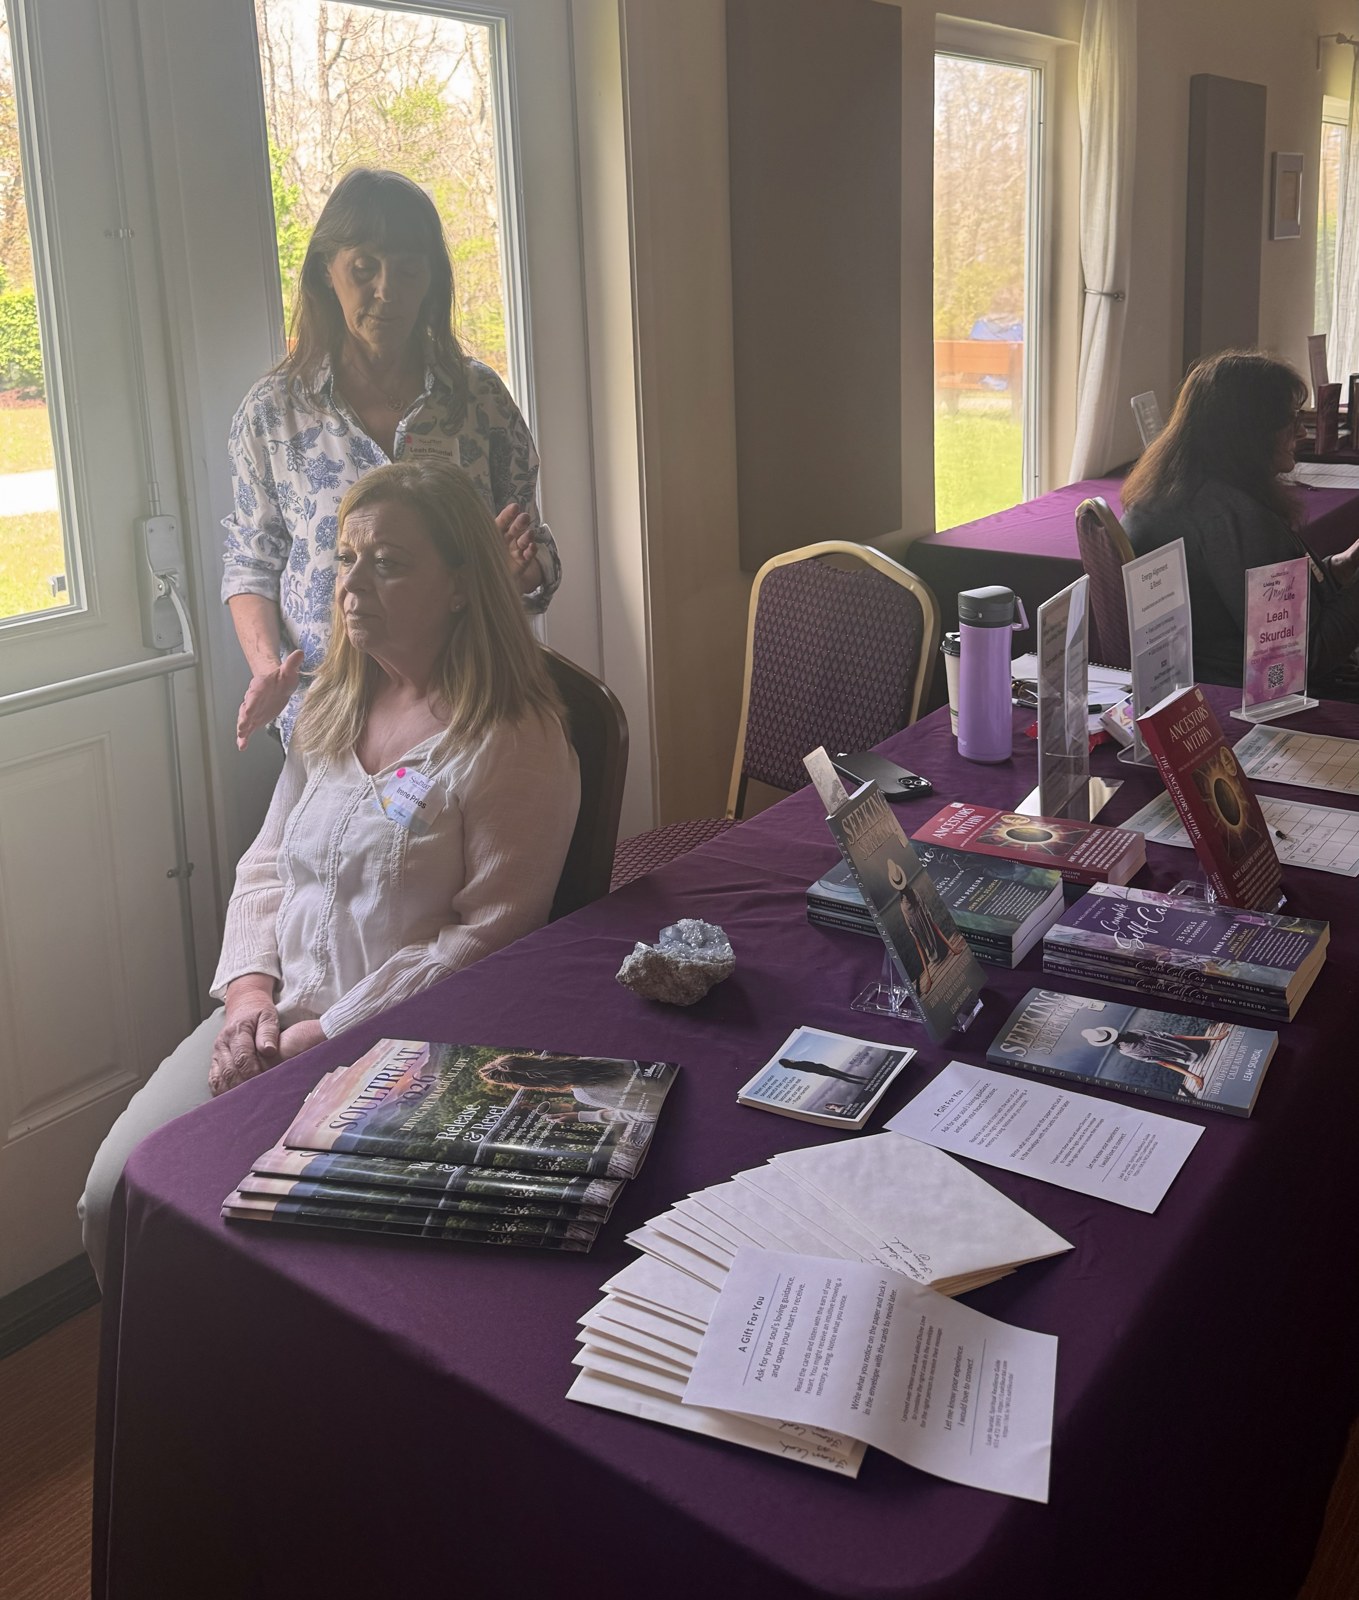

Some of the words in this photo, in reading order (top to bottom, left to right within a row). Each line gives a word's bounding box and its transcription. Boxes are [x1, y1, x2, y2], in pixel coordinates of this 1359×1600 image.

[1284, 592, 1296, 601] Life
[1266, 609, 1289, 623] Leah
[1260, 626, 1295, 644] Skurdal
[1169, 704, 1210, 742] ANCESTORS
[1182, 728, 1212, 754] WITHIN
[1160, 756, 1169, 770] THE
[1167, 772, 1190, 812] ANCESTORS
[1187, 812, 1202, 839] WITHIN
[841, 790, 889, 846] SEEKING
[932, 807, 975, 838] ANCESTORS
[953, 814, 986, 836] WITHIN
[836, 834, 864, 888] SEEKING
[866, 897, 898, 960] SERENITY
[953, 895, 966, 907] ANNA
[965, 876, 984, 895] PEREIRA
[1100, 903, 1131, 932] Complete
[1114, 899, 1173, 949] Self-Care
[1183, 921, 1197, 937] TOOLS
[1212, 940, 1226, 954] ANNA
[1222, 923, 1239, 943] PEREIRA
[1058, 946, 1083, 955] WELLNESS
[1085, 951, 1109, 960] UNIVERSE
[1237, 983, 1265, 993] PEREIRA
[1058, 966, 1083, 975] WELLNESS
[1085, 970, 1109, 979] UNIVERSE
[1239, 1001, 1266, 1011] PEREIRA
[1000, 990, 1065, 1057] SEEKING
[449, 1057, 470, 1070] LIFE
[1241, 1068, 1255, 1081] LEAH
[329, 1048, 426, 1132] SOULTREAT
[395, 1074, 437, 1110] 2026
[426, 1070, 460, 1099] MAGICAL
[1006, 1059, 1066, 1077] SEEKING
[1077, 1075, 1150, 1095] SERENITY
[1172, 1095, 1195, 1105] LEAH
[1194, 1100, 1225, 1112] SKURDAL
[418, 1100, 436, 1109] MY
[398, 1110, 428, 1131] LIVING
[435, 1104, 481, 1141] Release
[472, 1105, 508, 1130] Reset
[463, 1132, 484, 1143] &
[752, 1296, 764, 1310] You
[794, 1283, 806, 1305] receive.
[747, 1313, 758, 1326] For
[773, 1304, 787, 1322] loving
[886, 1302, 894, 1320] revisit
[784, 1314, 796, 1330] heart
[741, 1328, 754, 1343] Gift
[770, 1323, 780, 1340] soul's
[781, 1331, 790, 1345] your
[818, 1331, 827, 1349] receive
[764, 1341, 773, 1356] your
[827, 1334, 837, 1351] Notice
[759, 1357, 768, 1366] for
[776, 1347, 786, 1363] open
[794, 1378, 804, 1392] Read
[802, 1353, 811, 1367] cards
[809, 1327, 818, 1340] listen
[814, 1350, 822, 1365] might
[875, 1354, 883, 1367] with
[755, 1368, 765, 1381] Ask
[772, 1364, 780, 1378] and
[809, 1366, 818, 1376] You
[851, 1392, 861, 1410] Write
[857, 1376, 865, 1391] what
[864, 1344, 872, 1362] notice
[868, 1336, 874, 1344] on
[805, 1378, 815, 1394] heart.
[869, 1368, 880, 1396] envelope
[865, 1397, 874, 1408] the
[947, 1392, 956, 1408] know
[961, 1390, 969, 1403] love
[947, 1409, 954, 1419] me
